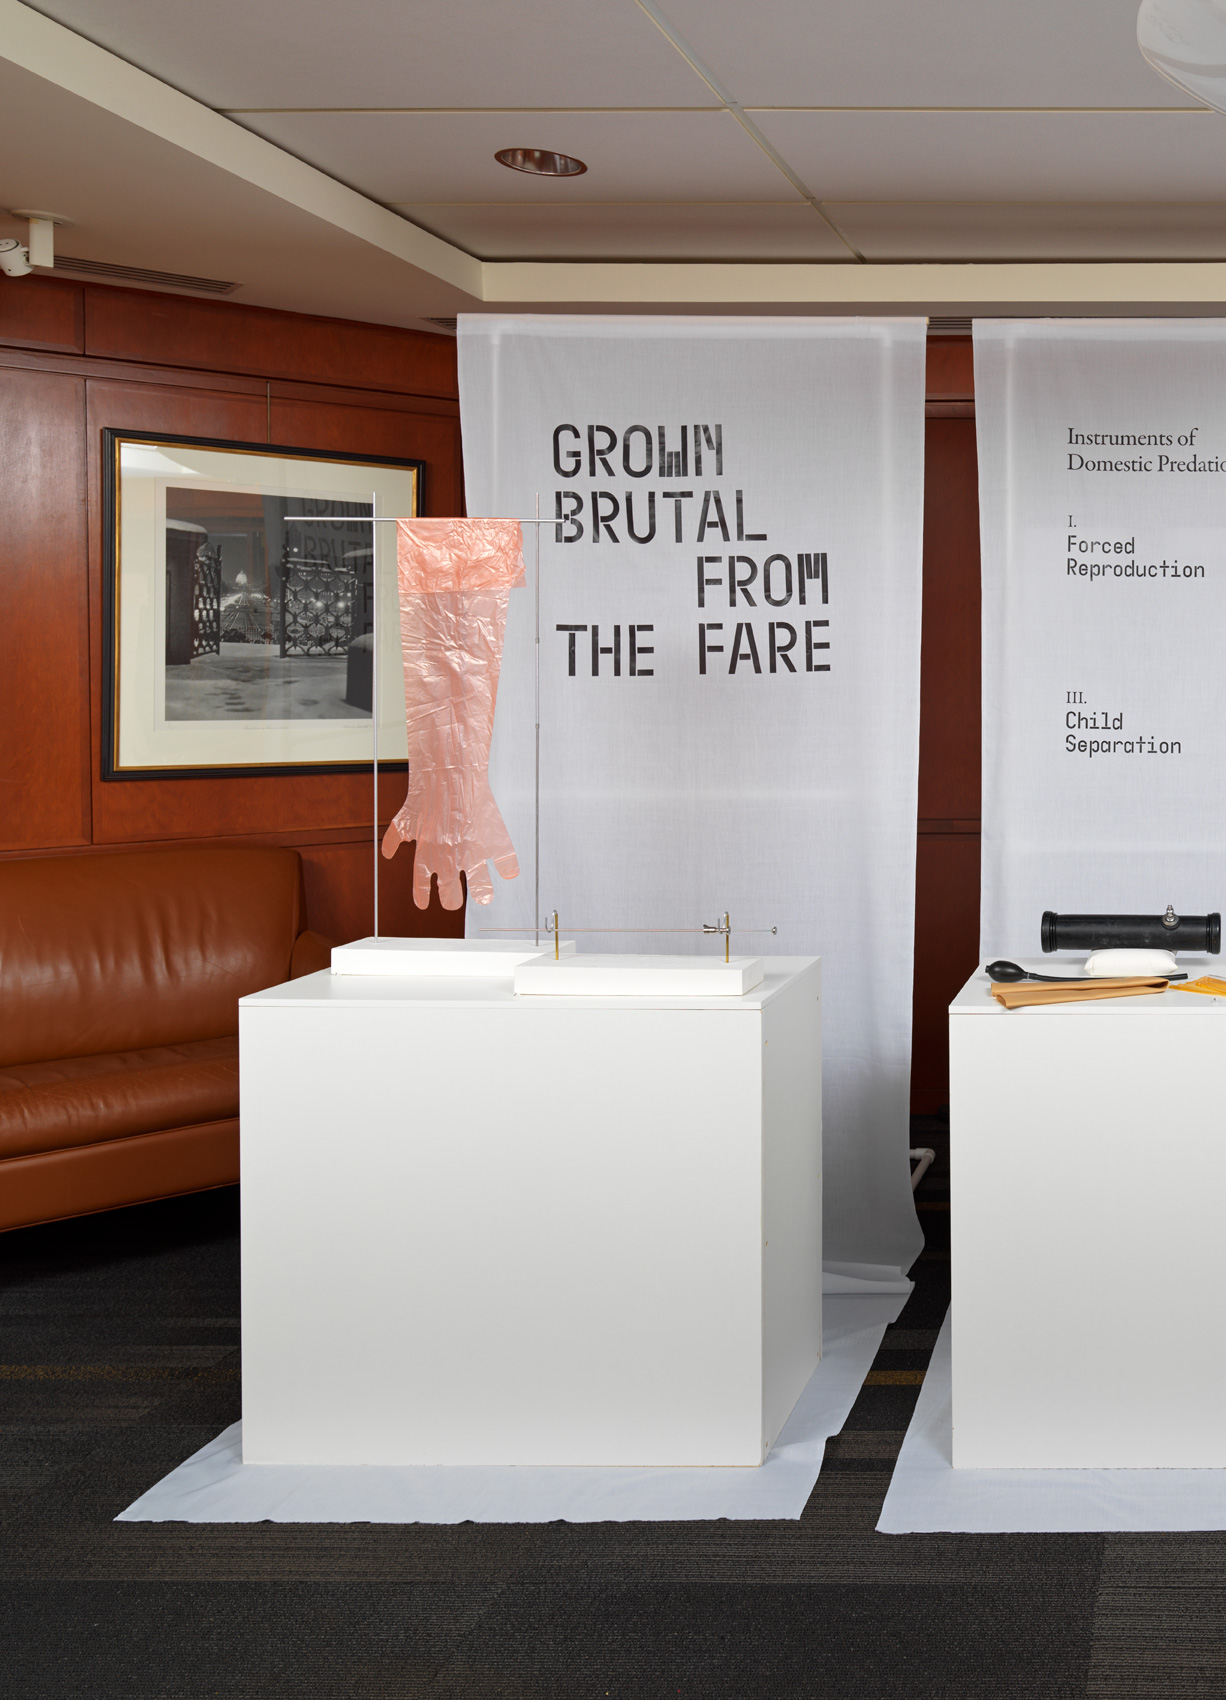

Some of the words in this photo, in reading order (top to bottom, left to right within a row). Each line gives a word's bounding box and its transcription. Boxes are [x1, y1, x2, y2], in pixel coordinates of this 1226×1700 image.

[1066, 427, 1173, 446] Instruments
[1177, 427, 1198, 446] of
[552, 423, 723, 478] GROWN
[1067, 453, 1153, 472] Domestic
[555, 489, 767, 544] BRUTAL
[1067, 514, 1077, 528] I.
[1067, 535, 1135, 554] Forced
[1066, 558, 1205, 581] Reproduction
[697, 553, 829, 608] FROM
[556, 624, 654, 676] THE
[698, 620, 831, 675] FARE
[1065, 691, 1087, 704] III.
[1065, 712, 1123, 730] Child
[1065, 734, 1182, 757] Separation
